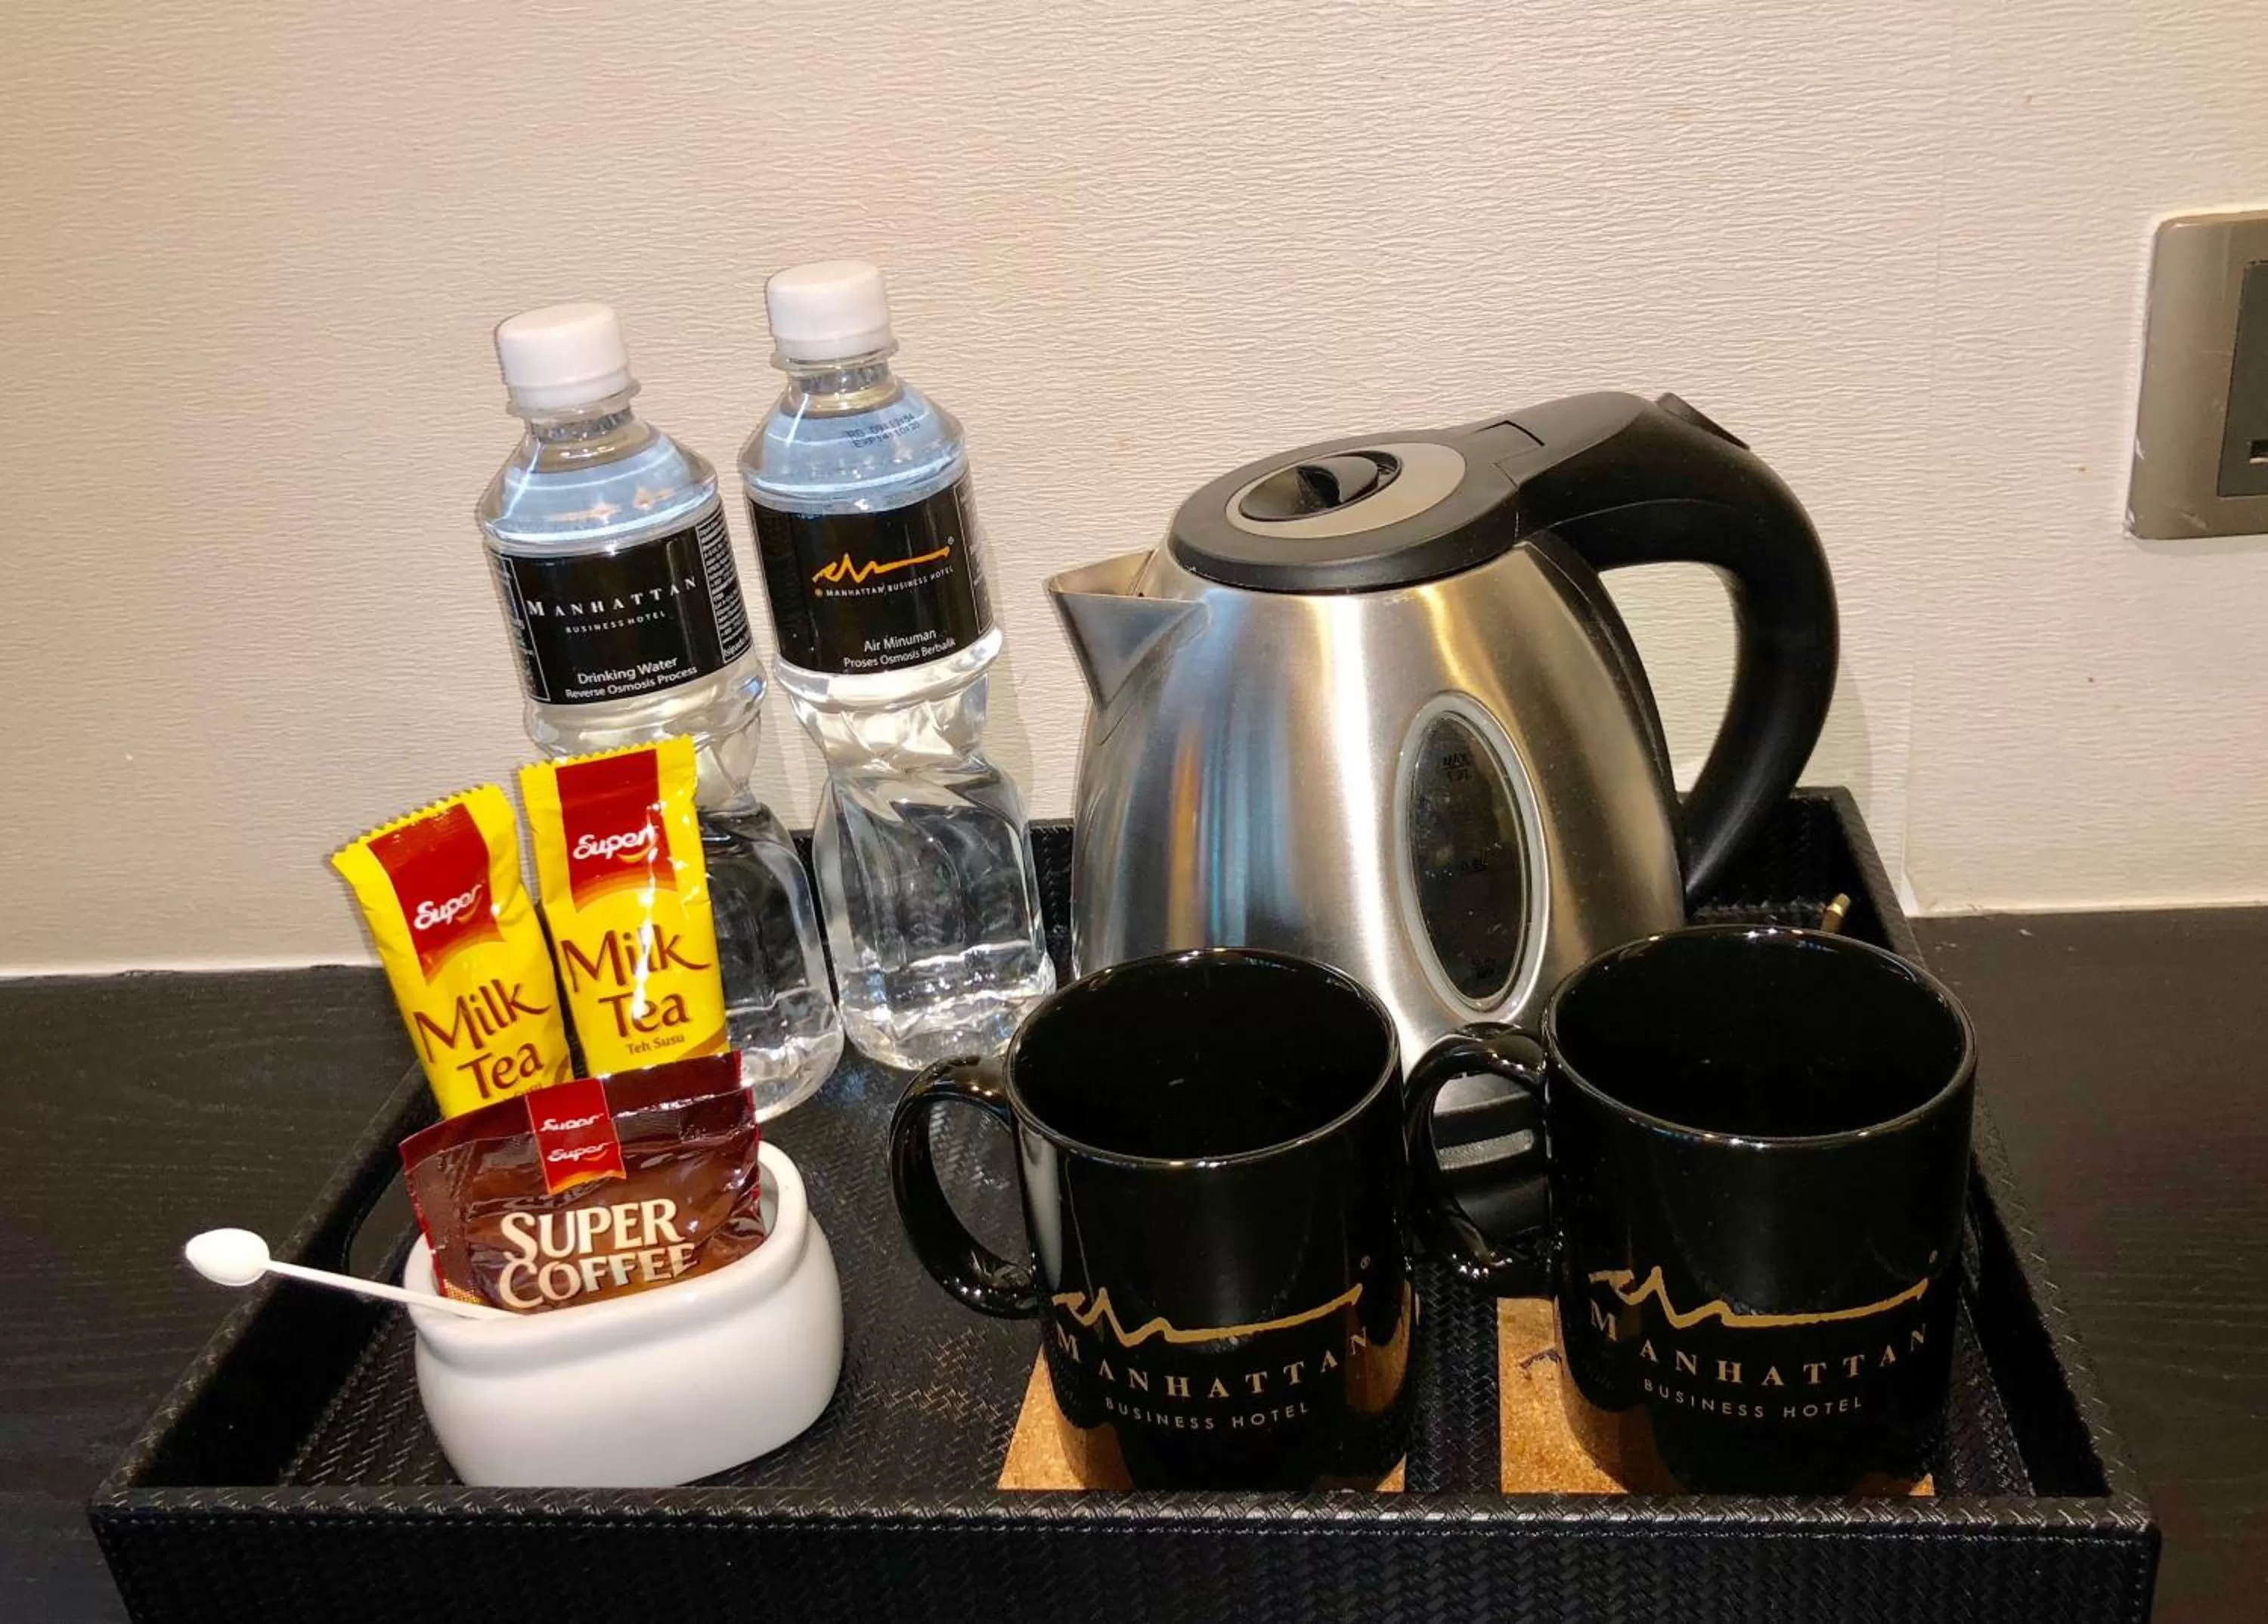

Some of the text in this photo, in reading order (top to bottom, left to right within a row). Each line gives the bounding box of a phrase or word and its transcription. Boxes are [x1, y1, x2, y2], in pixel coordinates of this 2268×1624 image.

[526, 575, 698, 617] MANHATTAN
[826, 566, 954, 597] MANHATTAN BUSINESS HOTEL
[565, 610, 666, 634] BUSINESS HOTEL
[864, 629, 937, 652] Air Minuman
[577, 657, 678, 685] Drinking Water
[844, 637, 956, 669] Proses Osmosis Berbalik
[565, 666, 698, 699] Reverse Osmosis Process
[572, 824, 661, 860] Super
[414, 882, 483, 931] Super
[560, 924, 711, 993] Milk
[412, 978, 551, 1065] Milk
[598, 992, 690, 1040] Tea
[626, 1034, 686, 1055] Teh Susu
[456, 1043, 545, 1101] Tea
[547, 1141, 615, 1162] Super
[499, 1198, 686, 1263] SUPER
[497, 1241, 700, 1309] COFFEE
[1056, 1321, 1368, 1399] MANHATTAN
[1590, 1298, 1927, 1387] MANHATTAN
[1105, 1396, 1310, 1430] BUSINESS HOTEL
[1644, 1378, 1863, 1419] BUSINESS HOTEL
